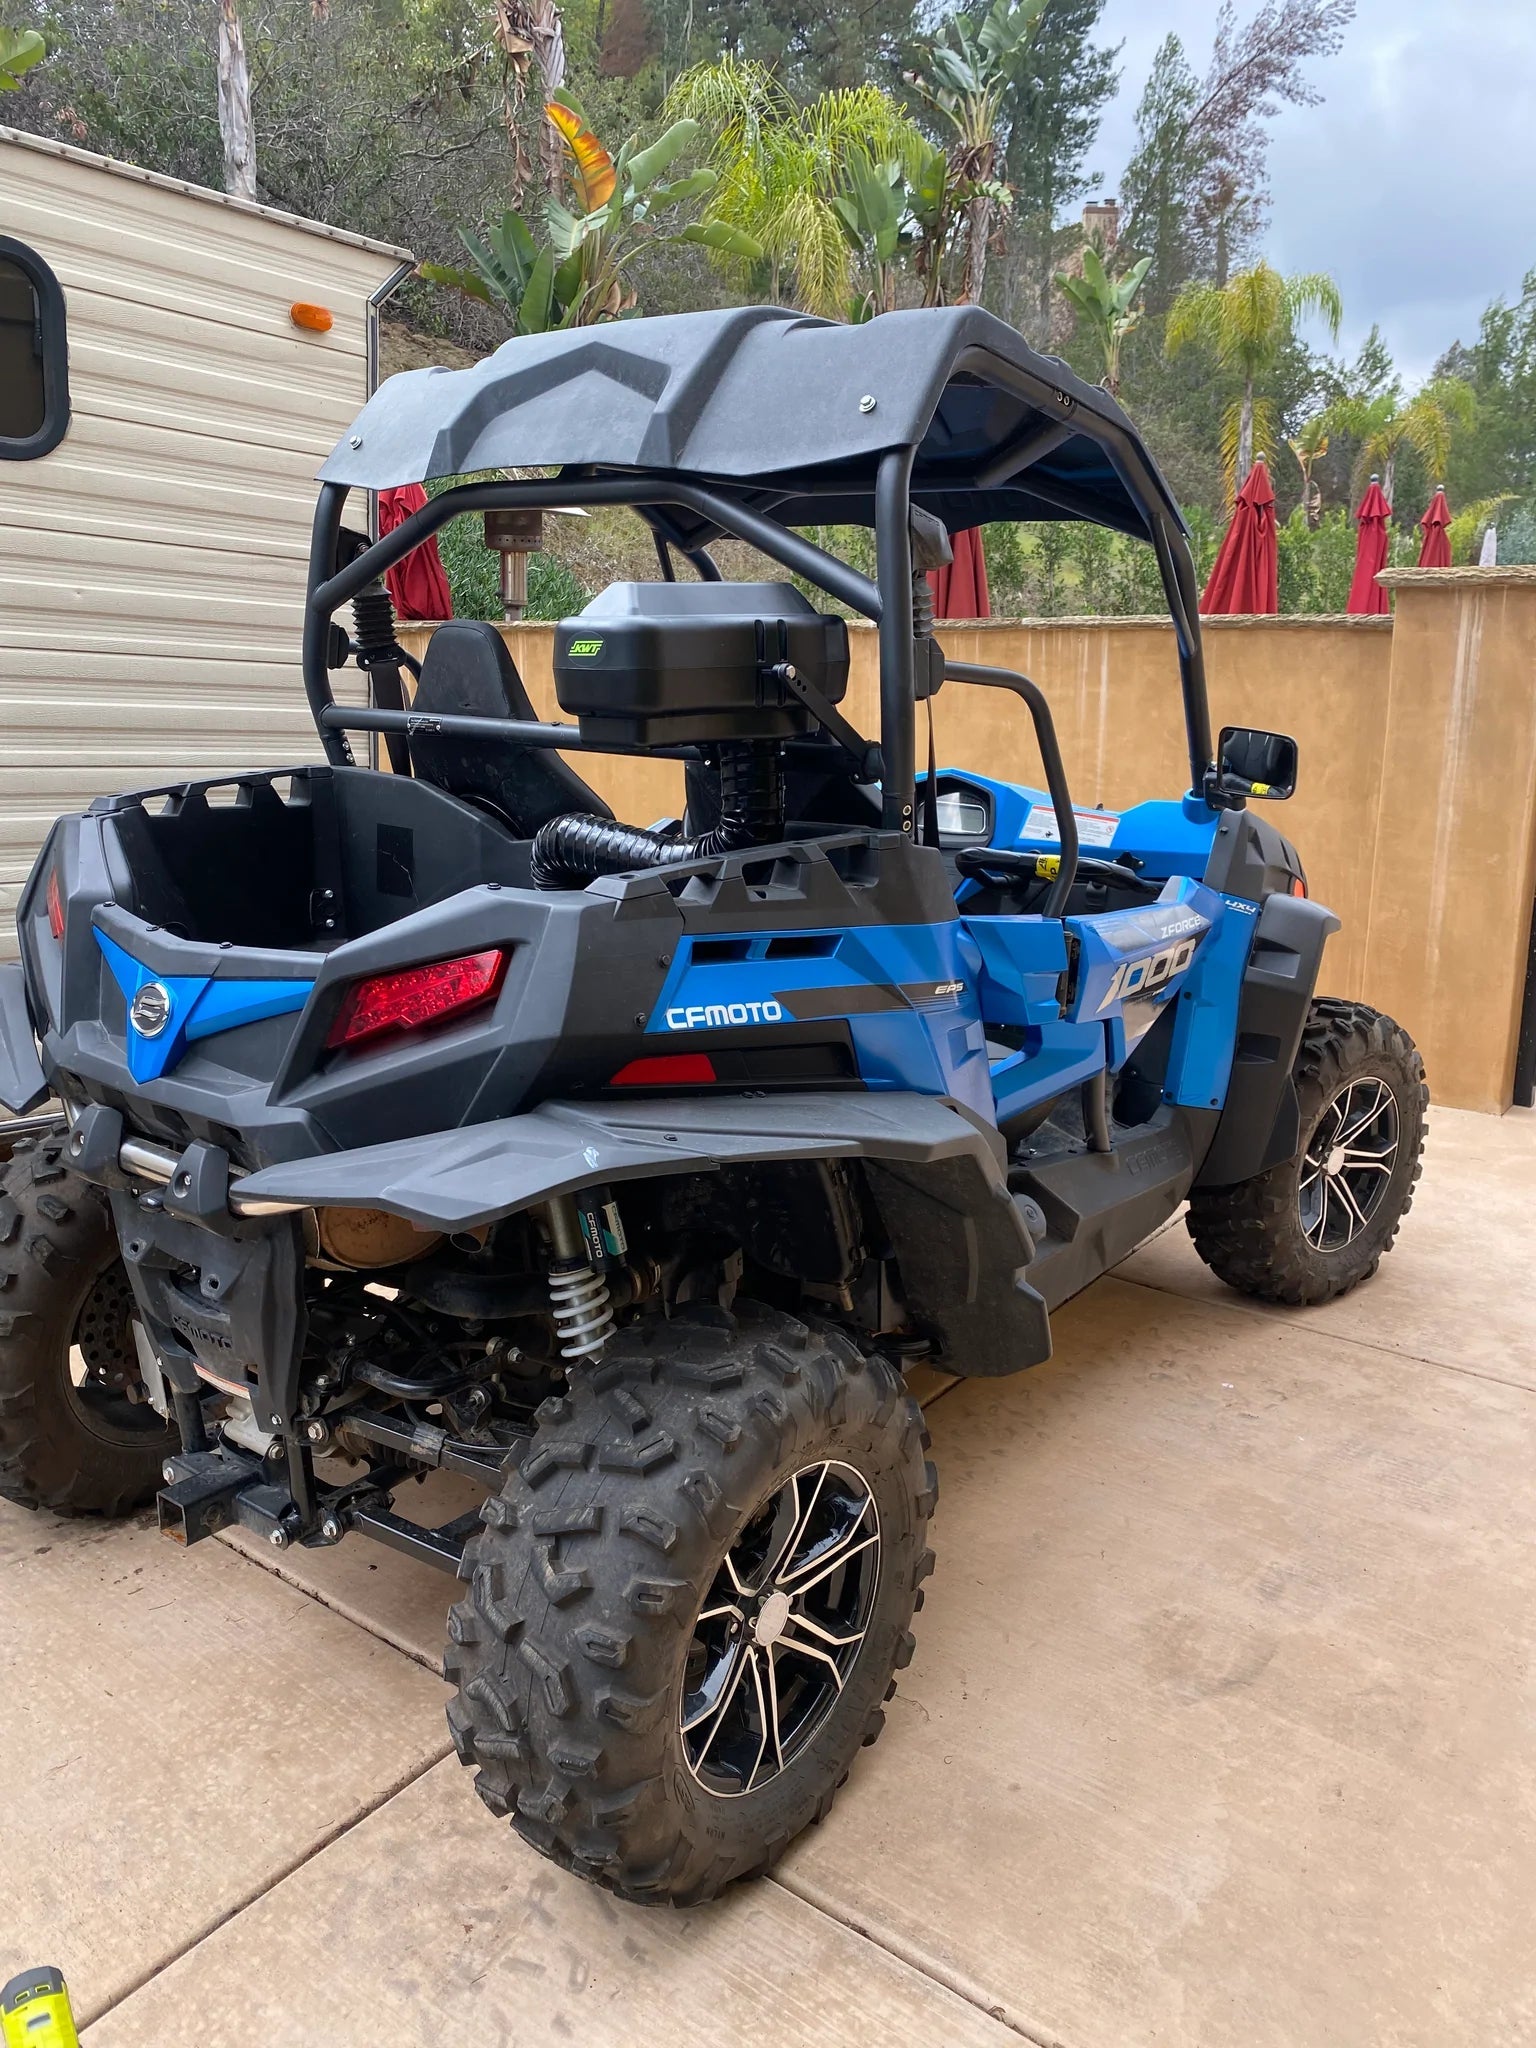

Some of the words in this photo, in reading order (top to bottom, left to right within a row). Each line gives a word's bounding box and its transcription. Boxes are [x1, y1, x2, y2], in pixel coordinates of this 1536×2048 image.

[570, 642, 603, 654] KWT
[1160, 914, 1201, 938] ZFORCE
[935, 982, 964, 994] EPS
[1096, 939, 1196, 1014] 1000
[666, 1001, 782, 1029] CFMOTO
[587, 1212, 603, 1258] CFMOTO
